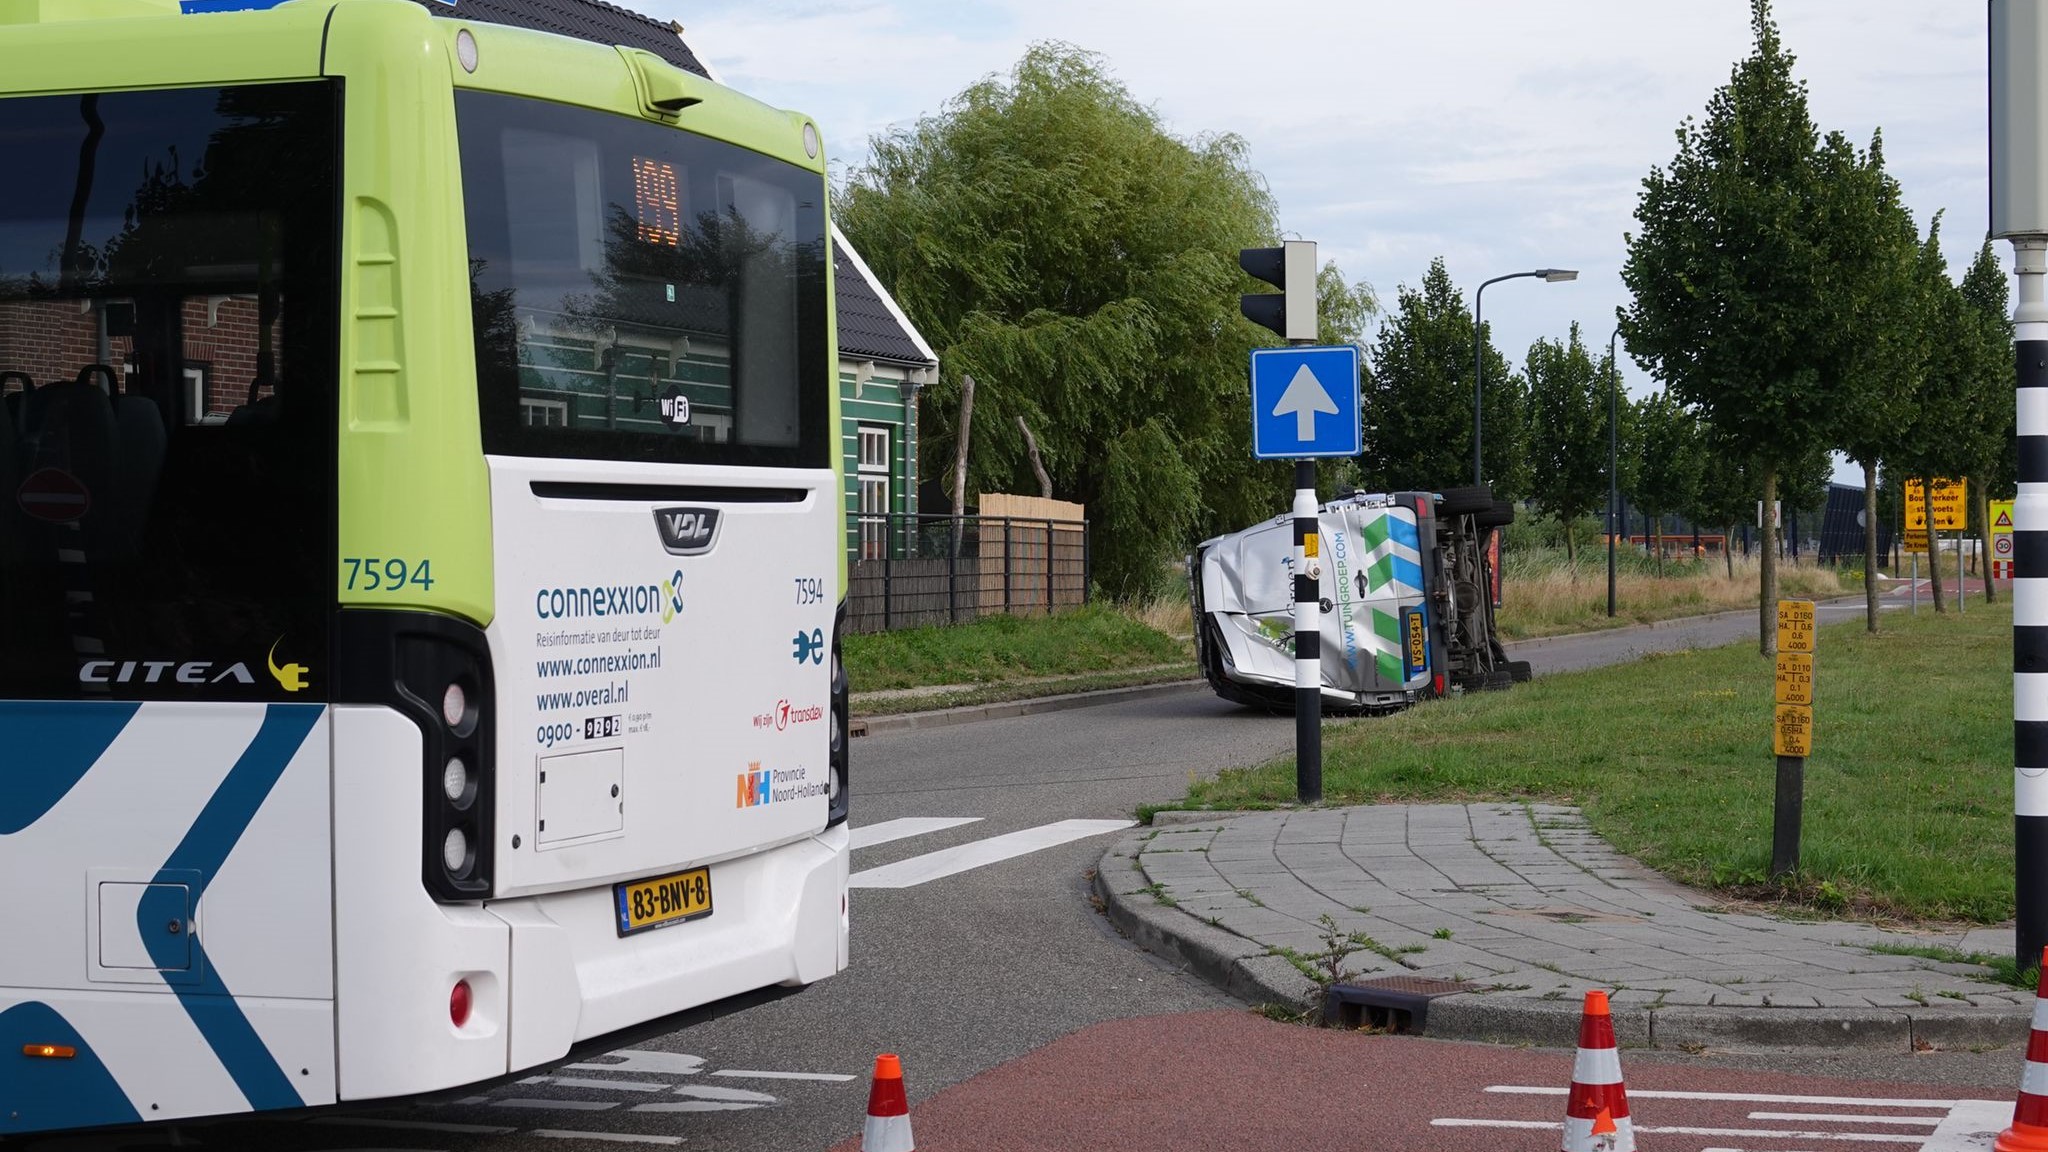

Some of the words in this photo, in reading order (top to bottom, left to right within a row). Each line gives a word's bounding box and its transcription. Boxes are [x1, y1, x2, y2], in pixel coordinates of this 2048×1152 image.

[632, 158, 678, 246] 199
[665, 514, 710, 539] VDL
[343, 558, 435, 592] 7594
[536, 585, 660, 619] connexxion
[794, 578, 823, 604] 7594
[1779, 611, 1788, 619] SA
[536, 629, 595, 648] Reisinformatie
[597, 632, 610, 644] van
[612, 628, 630, 642] deur
[630, 628, 642, 641] tot
[643, 626, 660, 640] deur
[79, 661, 255, 683] CITEA
[536, 646, 661, 678] www.connexxion.nl
[536, 680, 628, 710] www.overal.nl
[790, 704, 824, 724] transdev
[1776, 715, 1786, 723] SA
[536, 723, 572, 748] 0900
[586, 717, 620, 738] 9292
[773, 764, 806, 783] Provincie
[772, 780, 824, 803] Noord-Holland
[633, 876, 705, 920] 83-BNV-8
